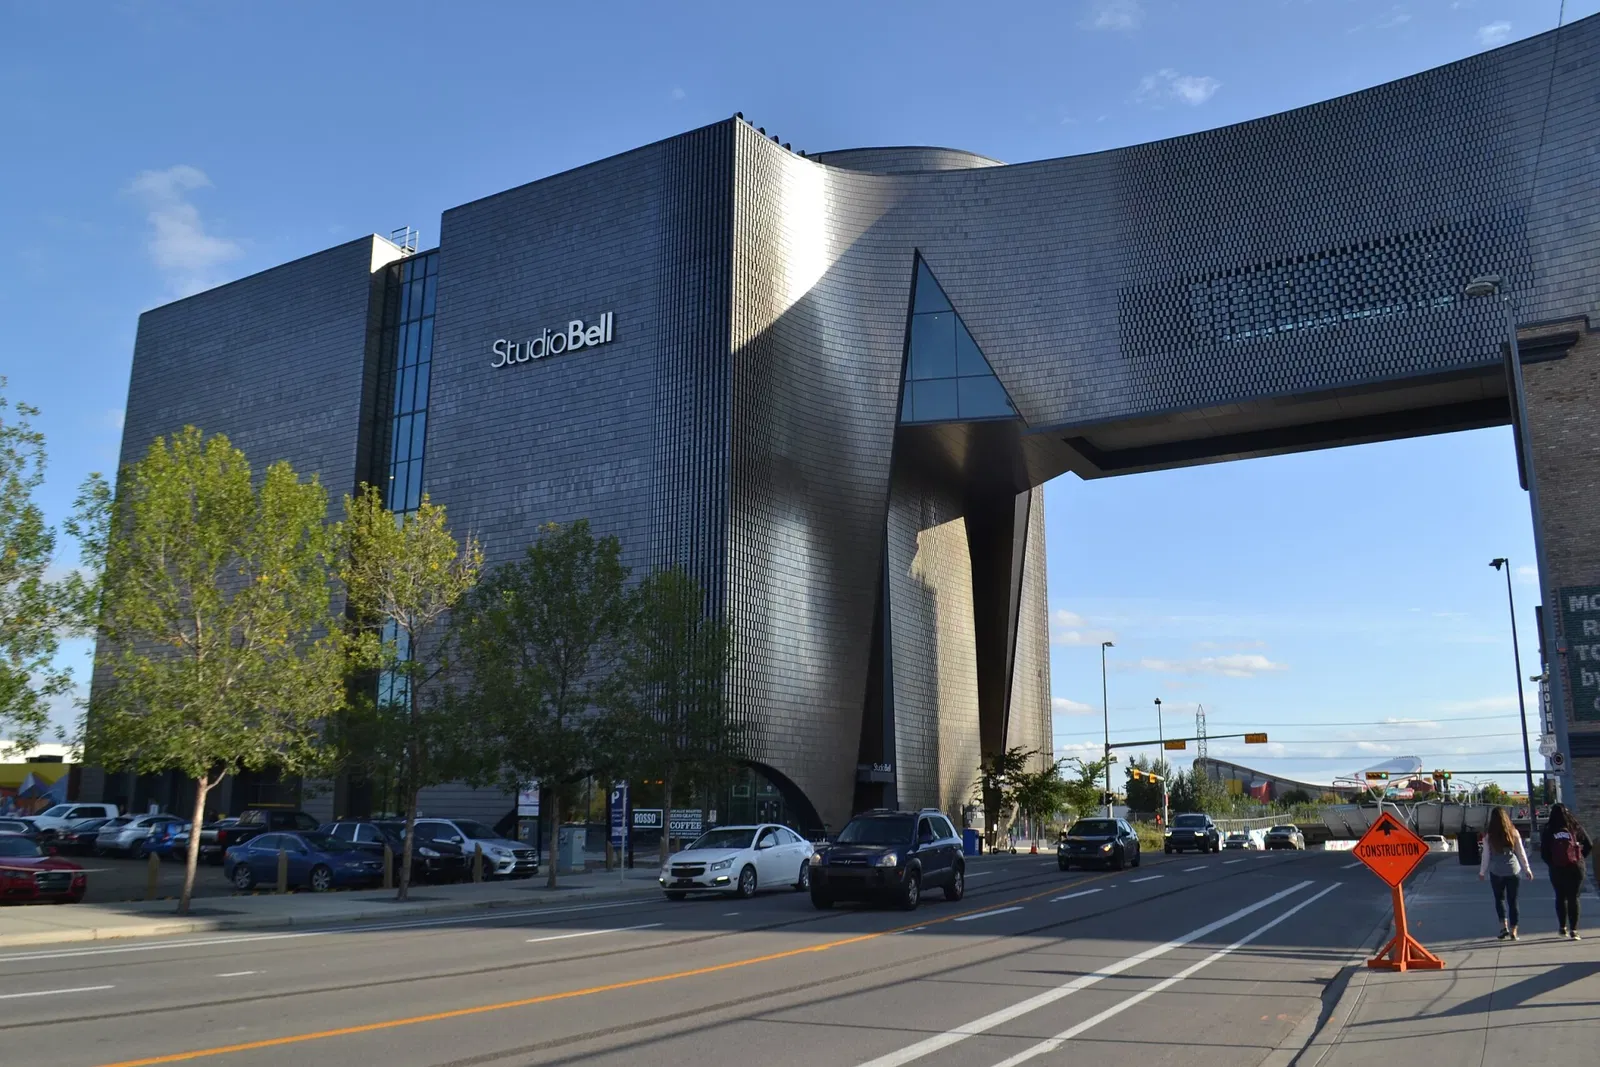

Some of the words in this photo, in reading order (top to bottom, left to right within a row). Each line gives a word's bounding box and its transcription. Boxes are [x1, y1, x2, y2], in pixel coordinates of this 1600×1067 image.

[491, 311, 613, 368] StudioBell
[1543, 683, 1554, 732] HOTEL
[611, 790, 620, 804] P
[634, 813, 656, 824] ROSSO
[669, 821, 702, 829] COFFEE
[1360, 843, 1419, 857] CONSTRUCTION
